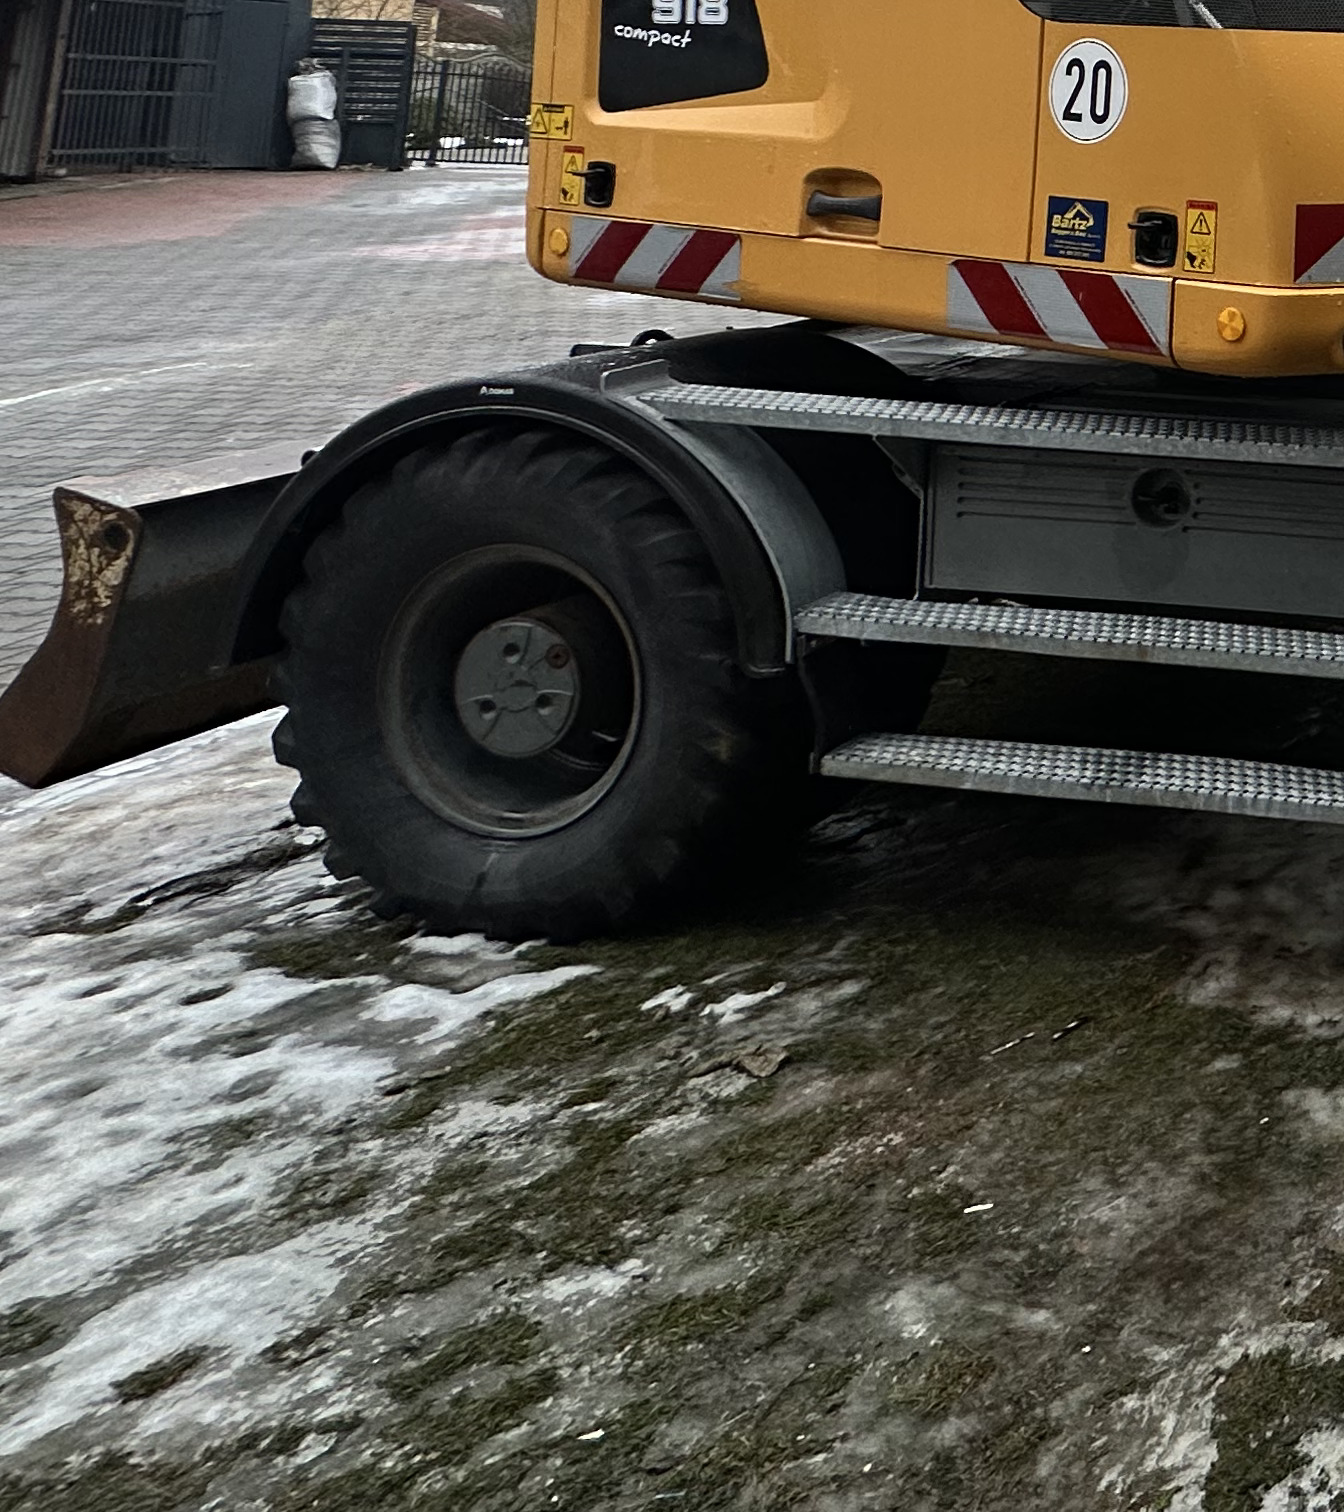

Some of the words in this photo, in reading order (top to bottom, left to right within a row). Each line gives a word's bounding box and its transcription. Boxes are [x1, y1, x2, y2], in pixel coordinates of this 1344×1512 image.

[614, 24, 692, 48] compact
[1062, 57, 1112, 125] 20
[1052, 214, 1088, 230] Bartz
